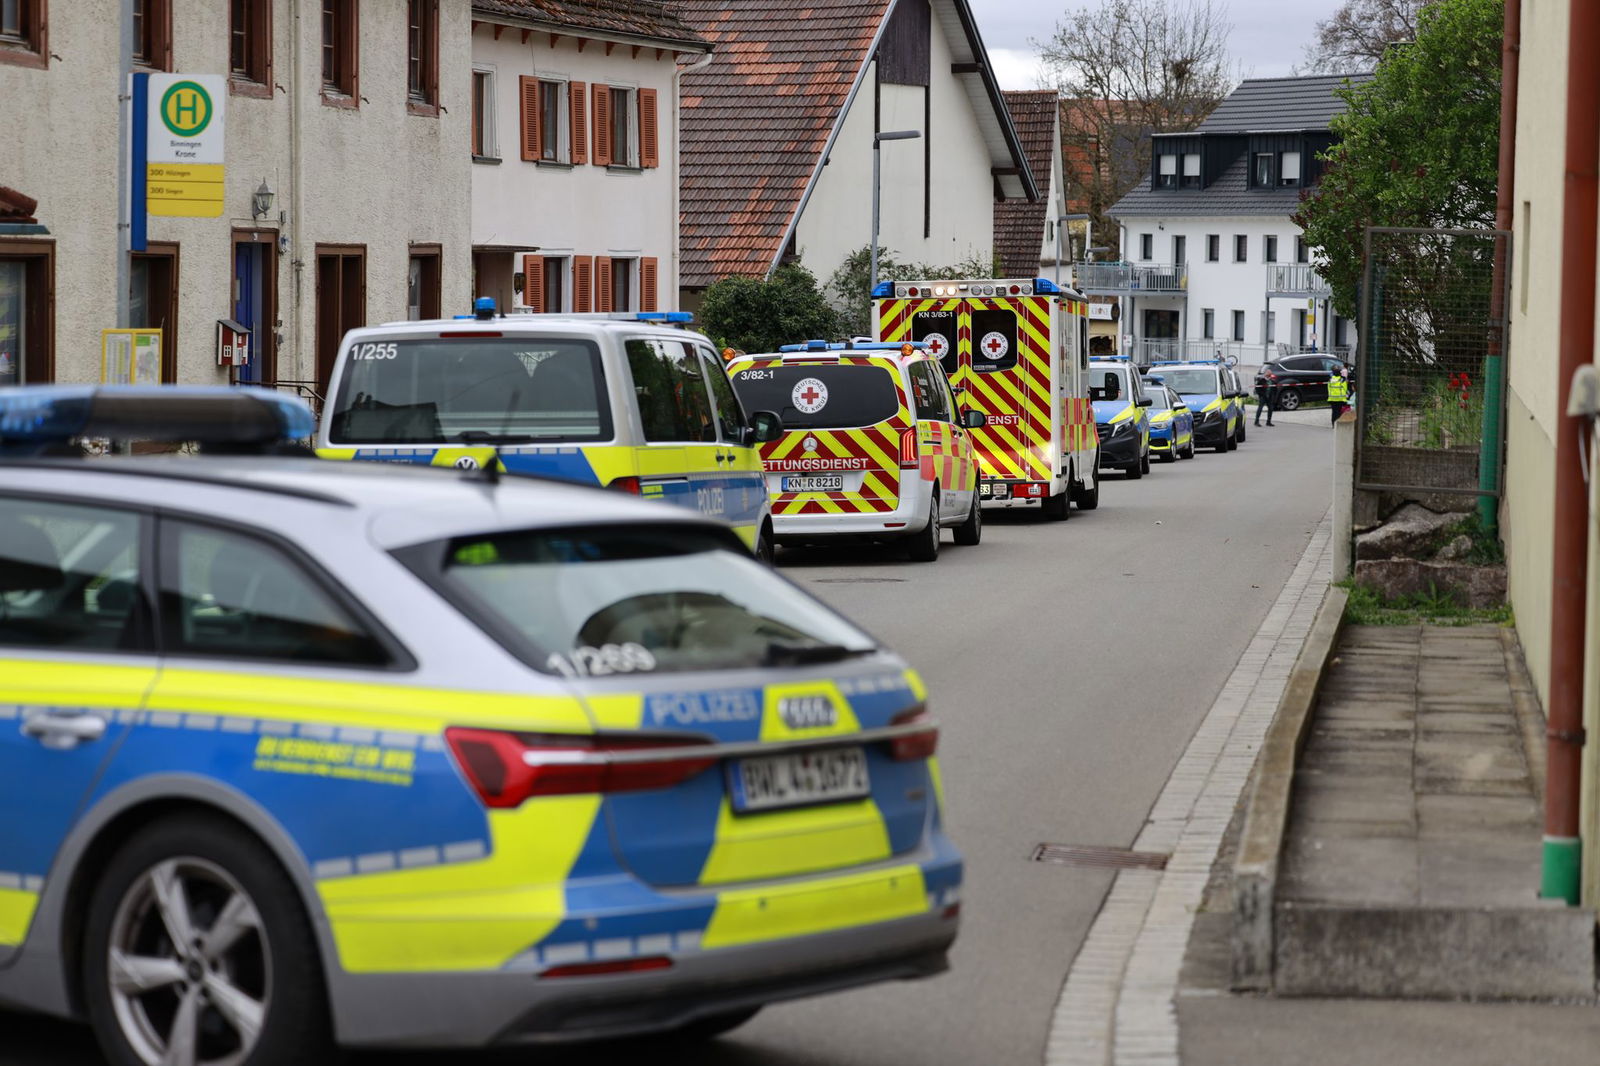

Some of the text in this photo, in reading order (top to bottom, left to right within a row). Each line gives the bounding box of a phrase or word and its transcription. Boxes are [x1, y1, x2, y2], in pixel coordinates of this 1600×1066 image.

[176, 93, 196, 124] H
[175, 150, 196, 158] Krone
[350, 343, 398, 361] 1/255
[740, 370, 774, 380] 3/82-1
[794, 379, 826, 393] DEUTSCHES
[762, 458, 869, 471] ETTUNGSDIENST
[788, 477, 841, 488] KN R 8218
[697, 487, 724, 515] POLIZEI
[650, 691, 760, 727] POLIZEI
